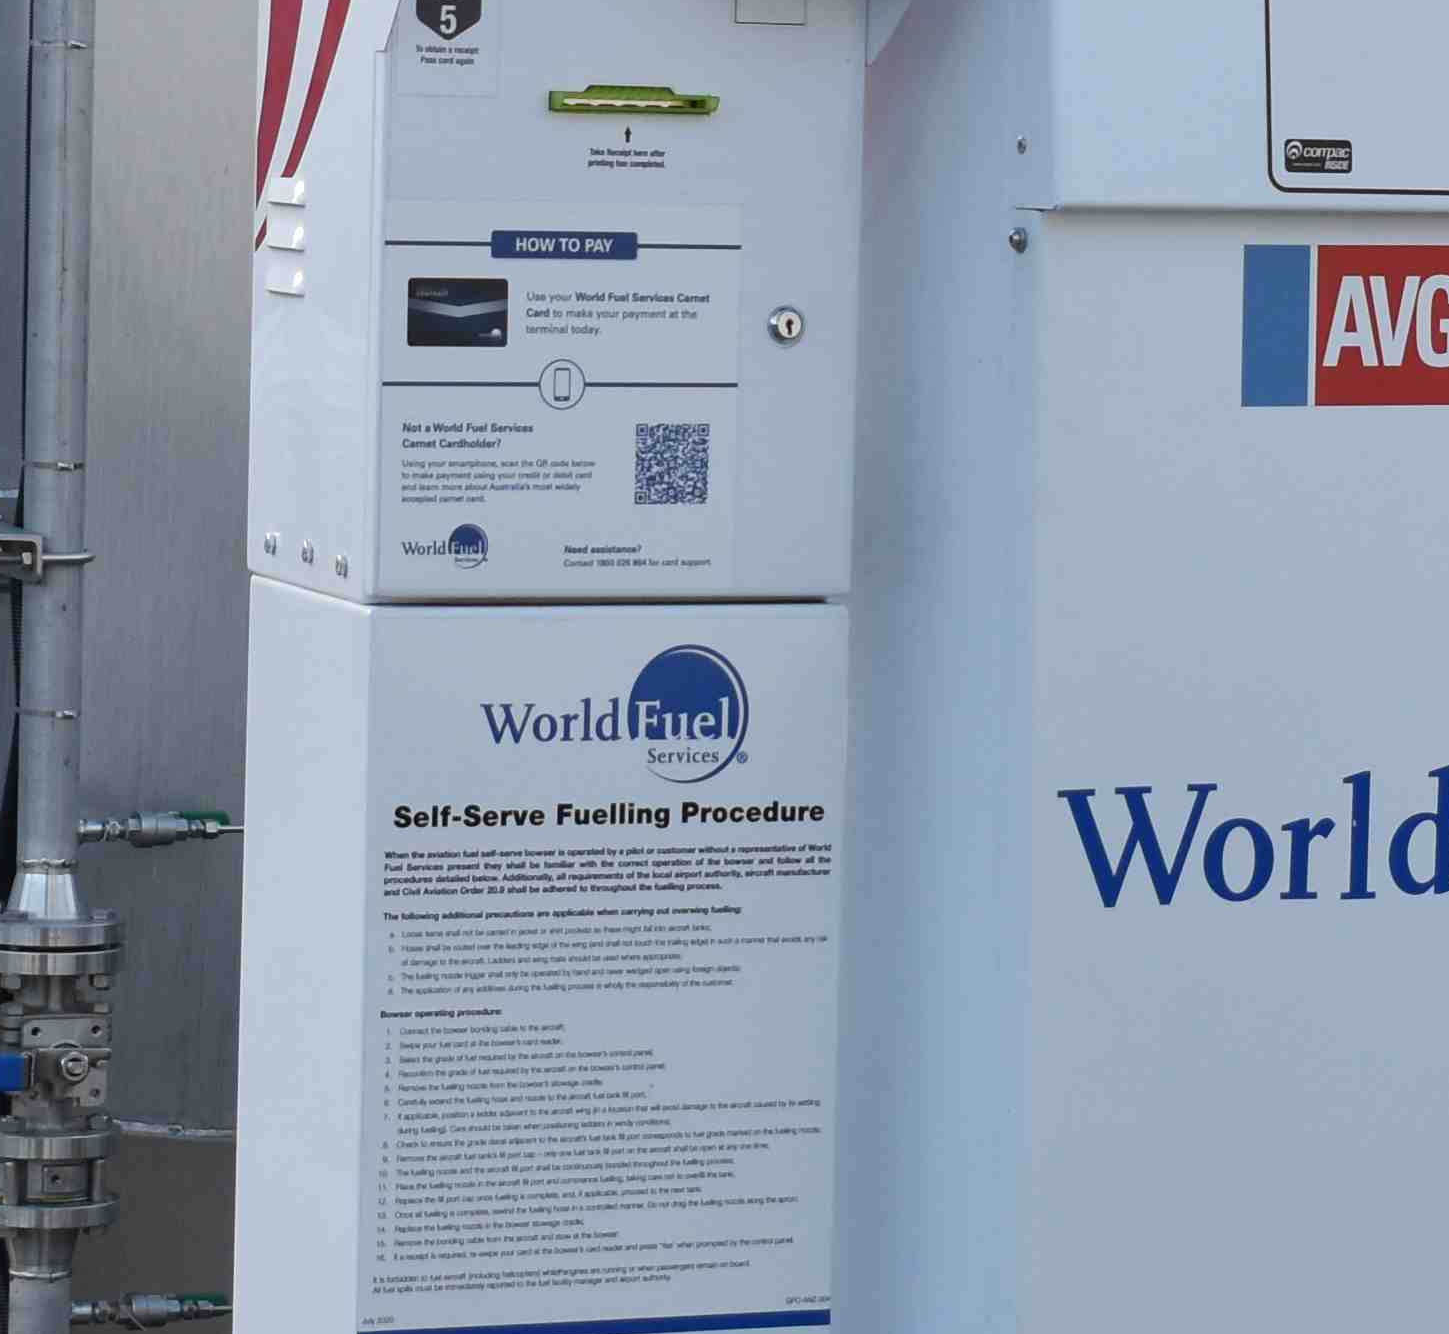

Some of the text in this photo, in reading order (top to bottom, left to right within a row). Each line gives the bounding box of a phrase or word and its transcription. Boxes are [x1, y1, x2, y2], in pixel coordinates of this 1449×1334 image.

[440, 5, 456, 34] 5
[1303, 147, 1350, 161] compac
[516, 238, 614, 253] HOW TO PAY
[527, 291, 546, 302] Use
[548, 293, 572, 304] your
[575, 292, 605, 302] World
[608, 292, 629, 303] Fuel
[632, 292, 674, 303] Services
[526, 308, 697, 322] Card to make your payment at the
[526, 324, 602, 337] terminal today.
[402, 422, 421, 433] Not
[433, 422, 463, 433] World
[466, 422, 487, 433] Fuel
[491, 422, 533, 433] Services
[439, 439, 501, 449] Cardholder?
[402, 542, 446, 556] World
[564, 545, 642, 554] Need assistance?
[480, 696, 734, 745] World Fuel
[647, 747, 719, 765] Services
[393, 800, 825, 829] Self-Serve Fuelling Procedure
